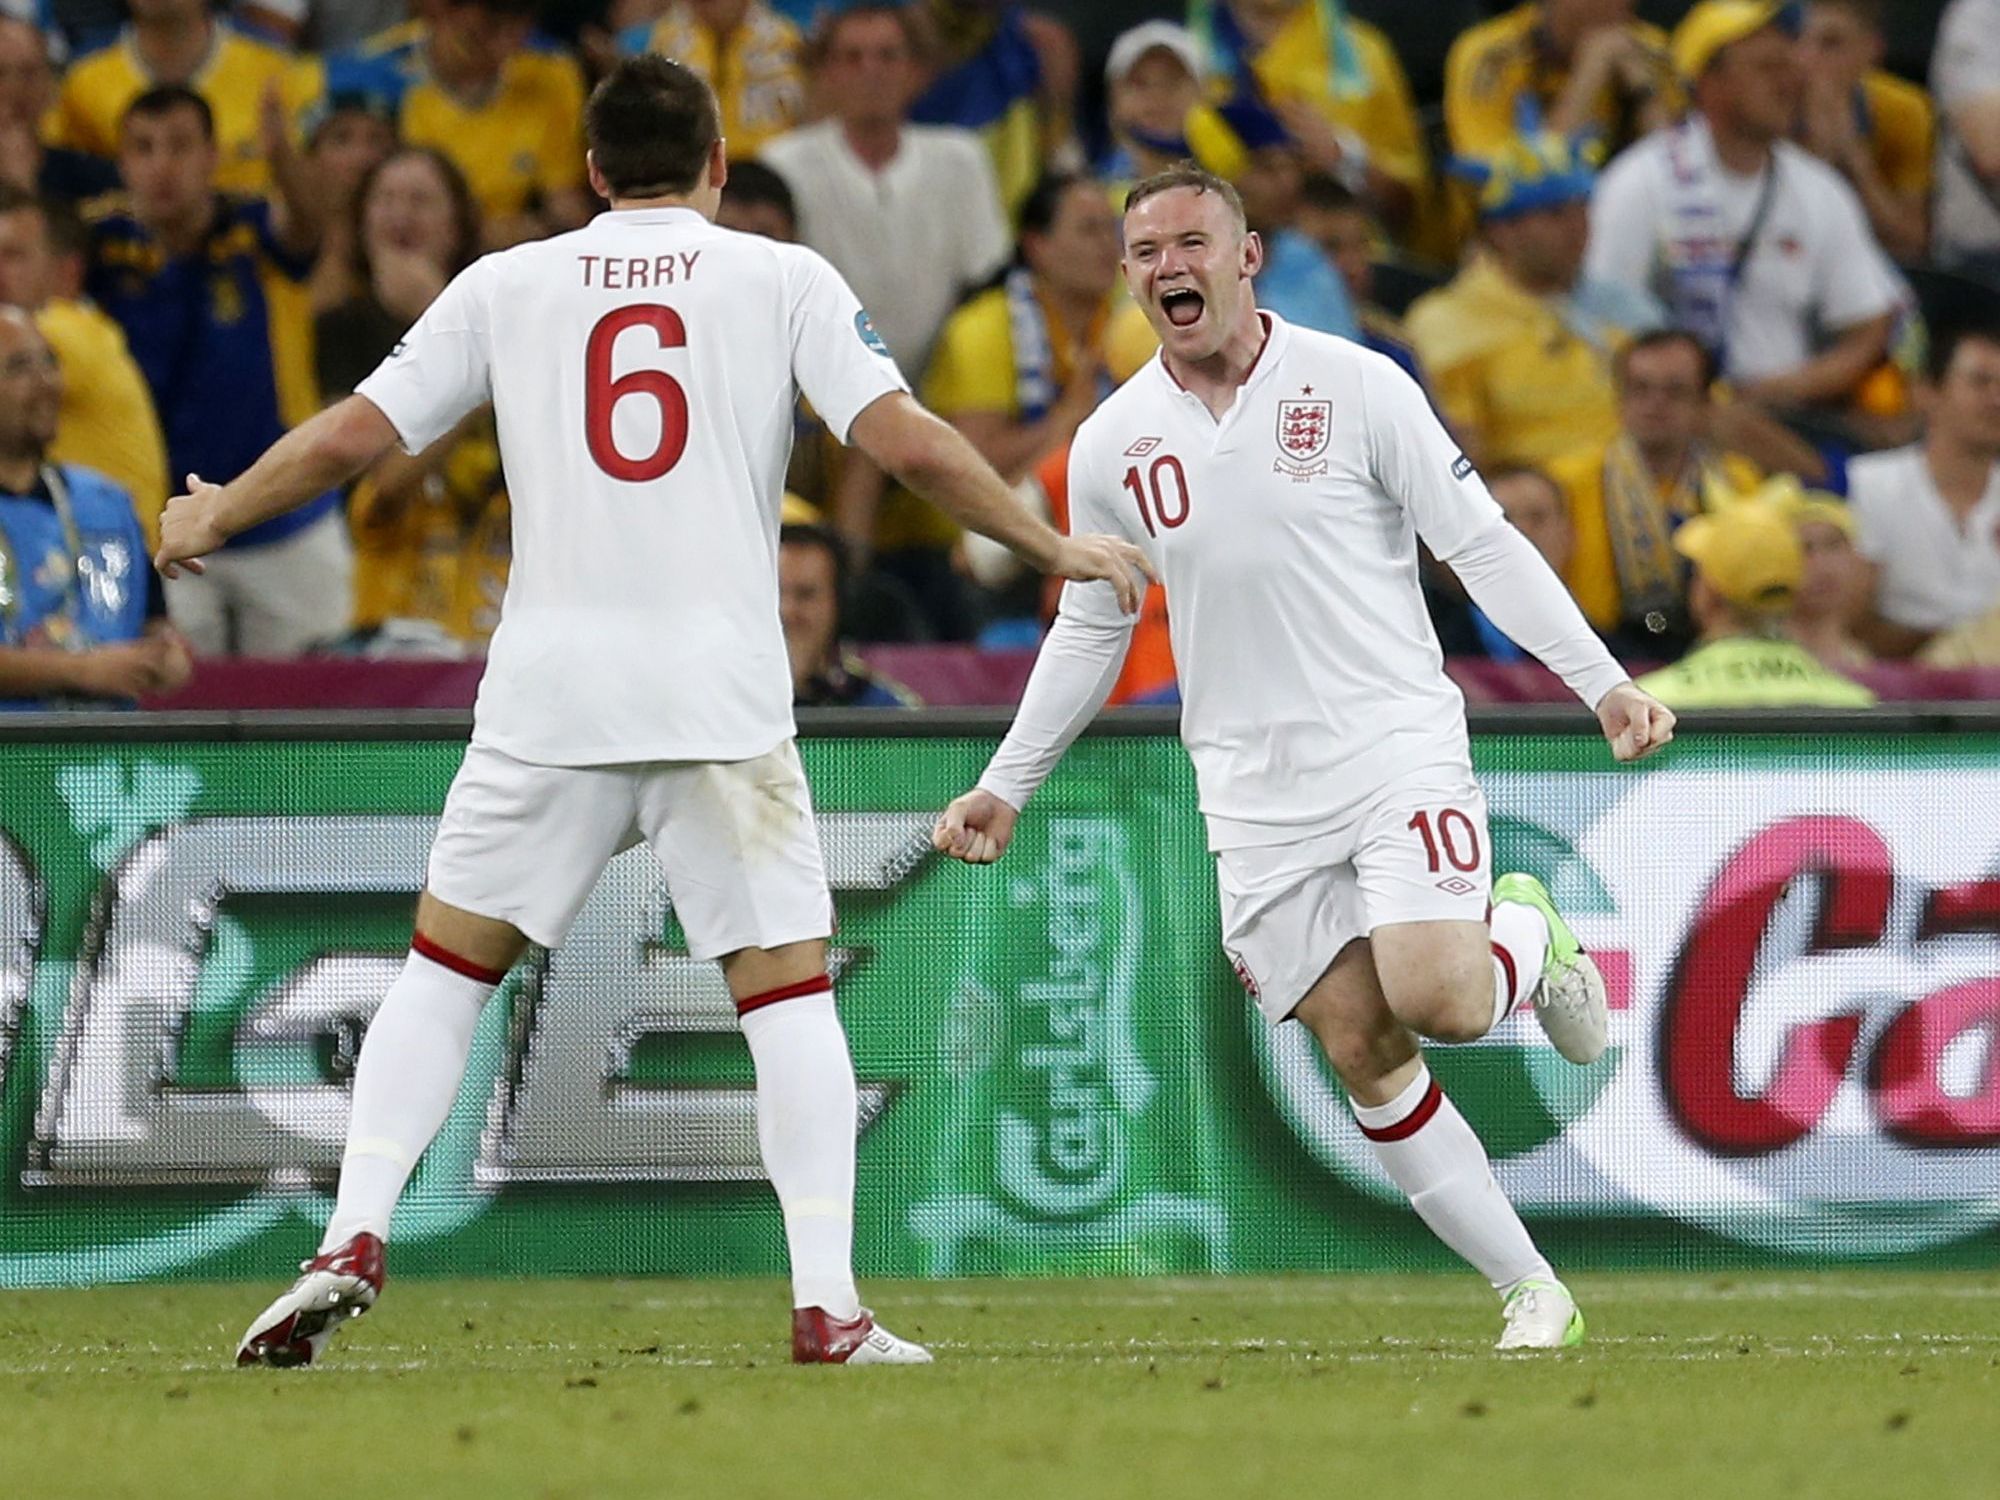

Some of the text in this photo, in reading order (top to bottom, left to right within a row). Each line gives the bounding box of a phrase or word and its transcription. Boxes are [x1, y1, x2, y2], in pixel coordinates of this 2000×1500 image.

[577, 249, 701, 289] TERRY
[584, 302, 689, 482] 6
[1122, 454, 1190, 538] 10
[1407, 807, 1481, 873] 10
[994, 818, 1160, 1214] Carlsberg
